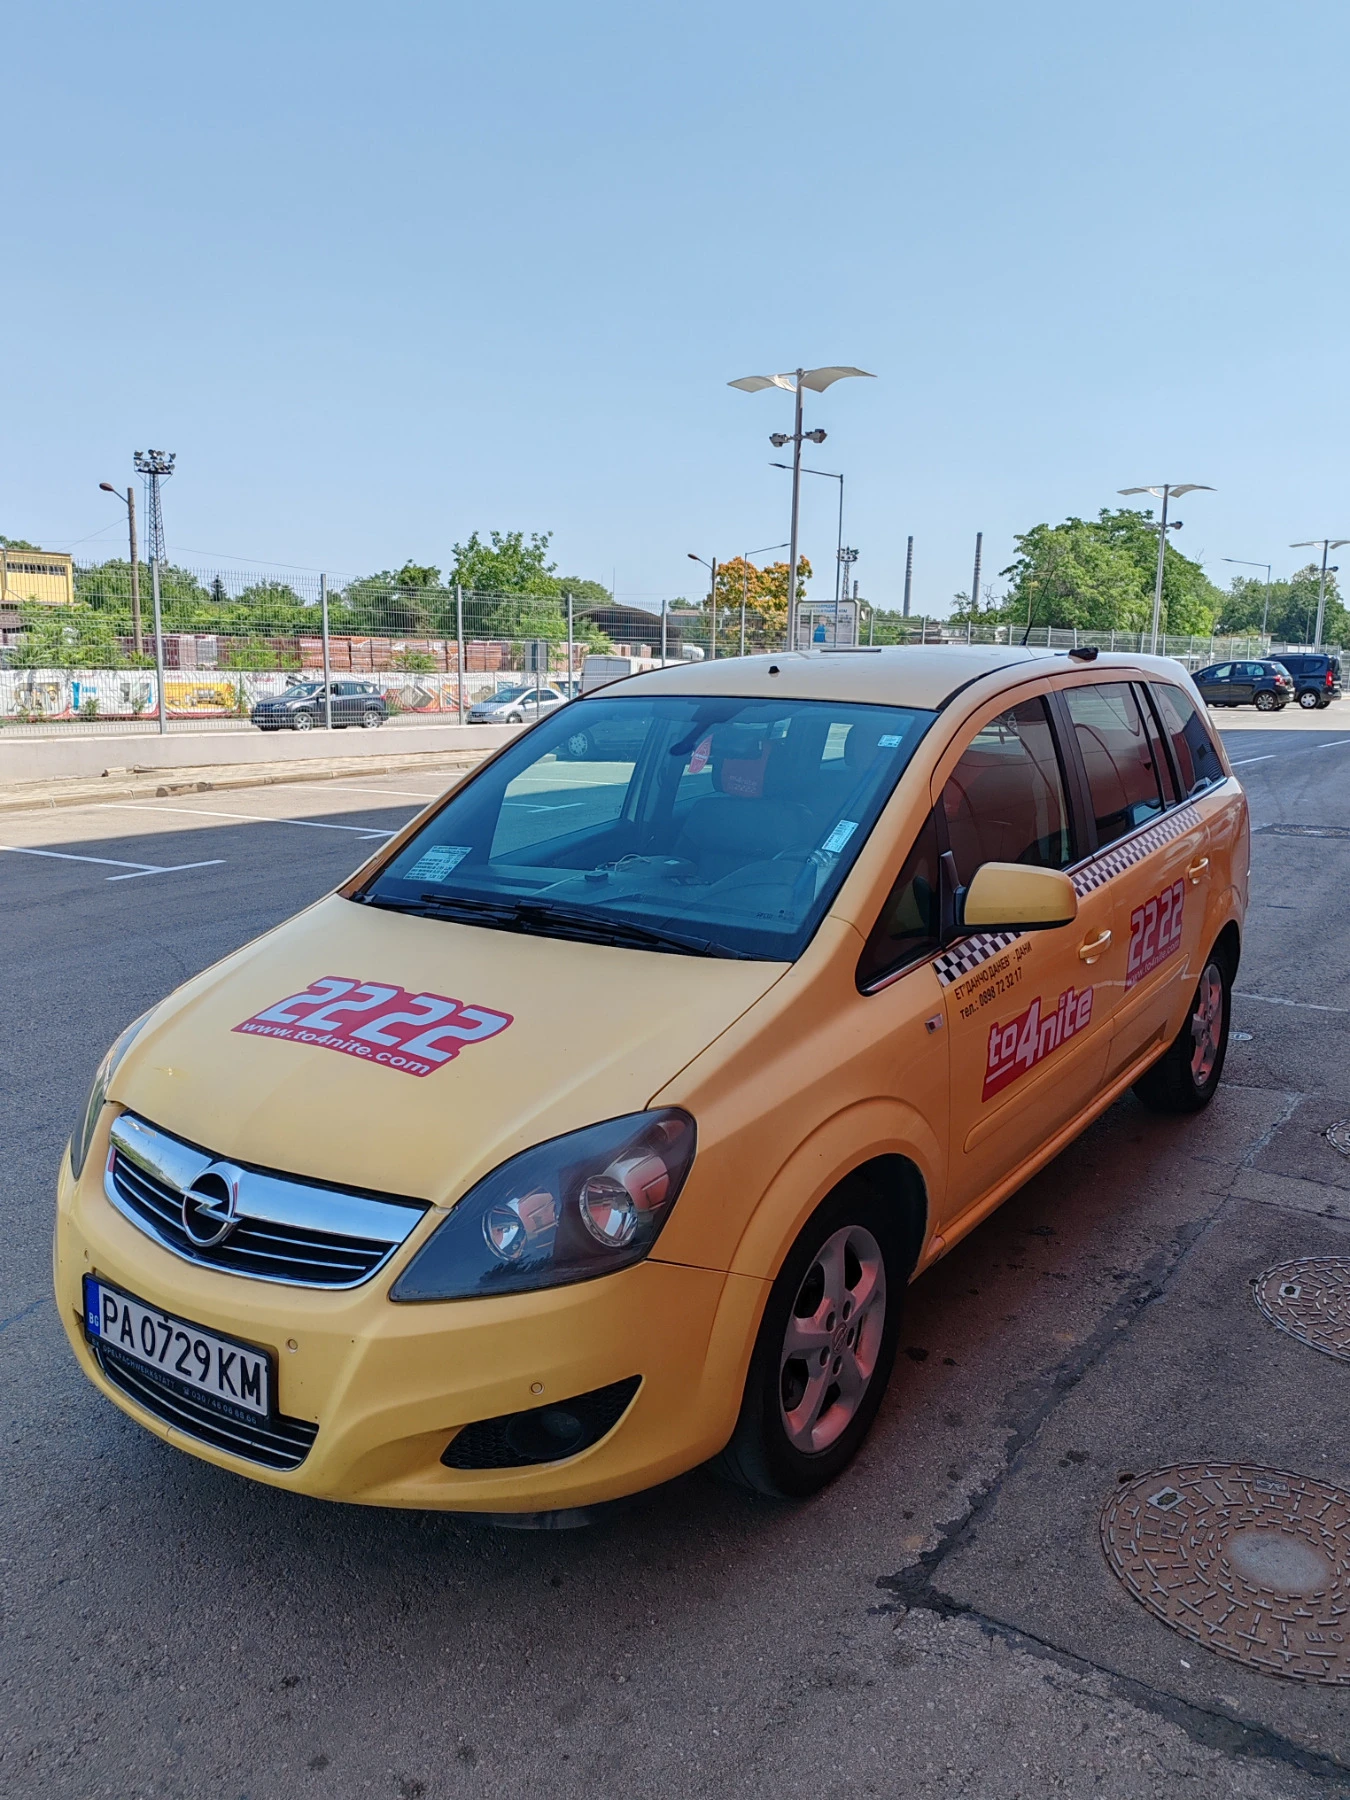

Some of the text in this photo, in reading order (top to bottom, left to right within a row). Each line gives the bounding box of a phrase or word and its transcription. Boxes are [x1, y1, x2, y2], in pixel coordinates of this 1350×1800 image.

[1127, 880, 1184, 974] 2222
[254, 978, 508, 1063] 2222
[979, 985, 996, 1007] 0898
[996, 979, 1006, 995] 72
[1005, 972, 1015, 989] 32
[1014, 966, 1023, 982] 17
[241, 1021, 431, 1075] www.to4nite.com
[988, 986, 1094, 1068] to4nite
[88, 1311, 99, 1327] BG
